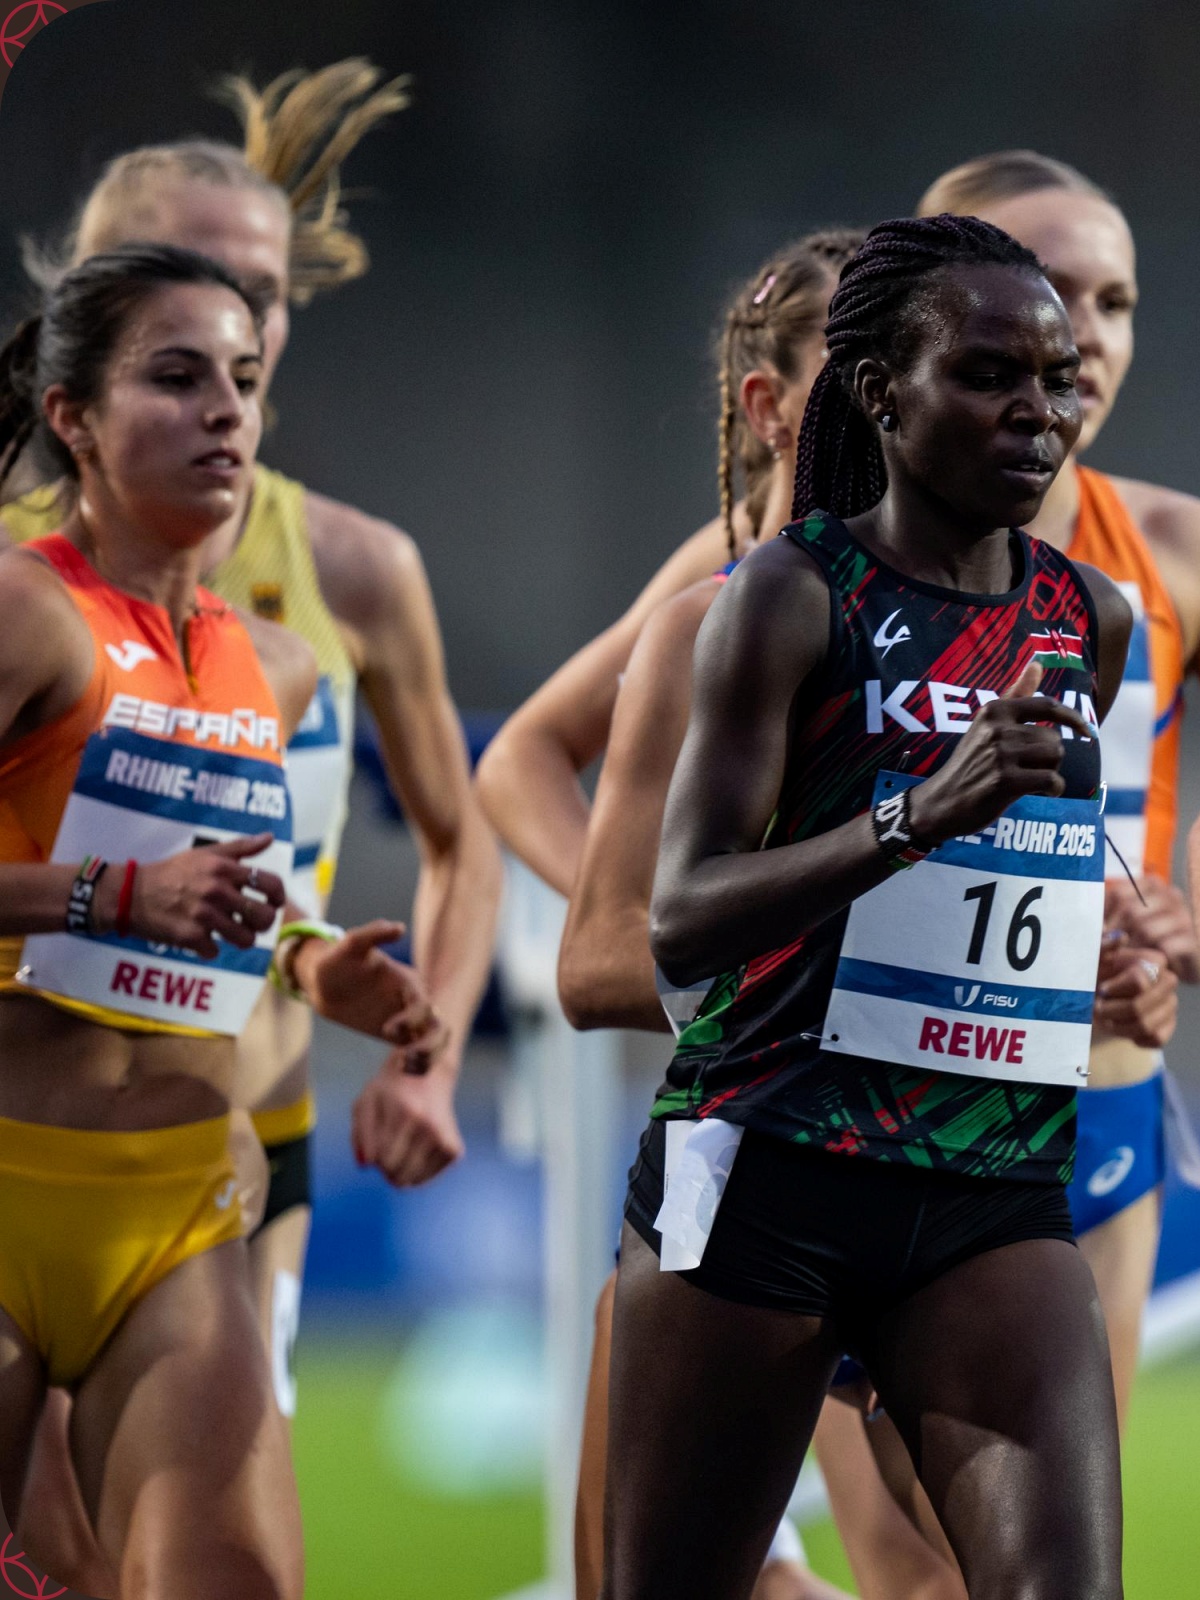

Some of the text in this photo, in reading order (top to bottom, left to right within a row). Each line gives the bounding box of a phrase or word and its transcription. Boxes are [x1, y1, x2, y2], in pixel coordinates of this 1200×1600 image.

[103, 692, 279, 751] ESPAÑA
[105, 749, 286, 820] RHINE-RUHR 2025
[1056, 823, 1096, 858] 2025
[963, 881, 1044, 972] 16
[109, 959, 214, 1013] REWE
[982, 993, 1019, 1009] FISU
[918, 1016, 1026, 1065] REWE
